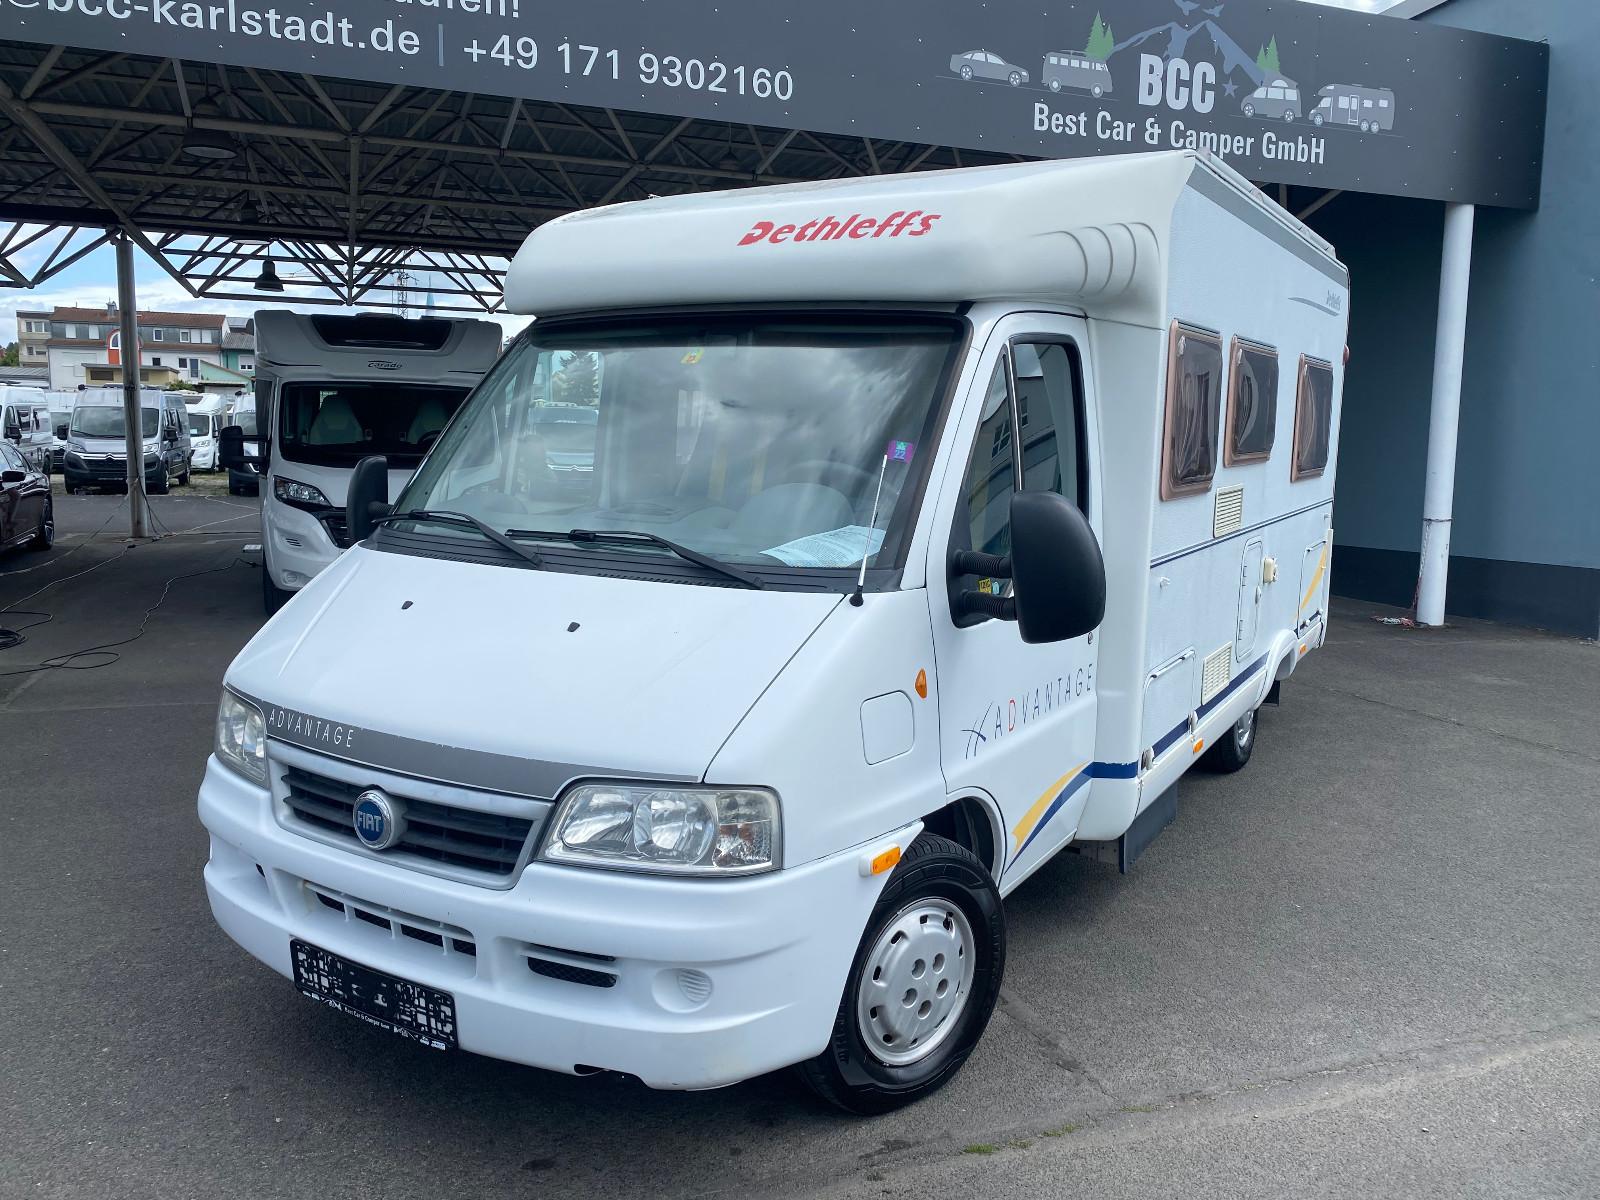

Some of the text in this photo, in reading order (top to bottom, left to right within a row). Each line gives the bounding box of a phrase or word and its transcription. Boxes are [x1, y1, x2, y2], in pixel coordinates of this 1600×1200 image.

[463, 34, 539, 70] +49
[557, 43, 620, 80] 171
[638, 53, 793, 101] 9302160
[1138, 53, 1216, 114] BCC
[1033, 102, 1326, 164] Best Car & Camper GmbH
[736, 210, 942, 247] Dethleffs
[268, 707, 355, 748] ADVANTAGE
[992, 663, 1094, 740] ADVANTAGE
[356, 810, 383, 833] FIAT
